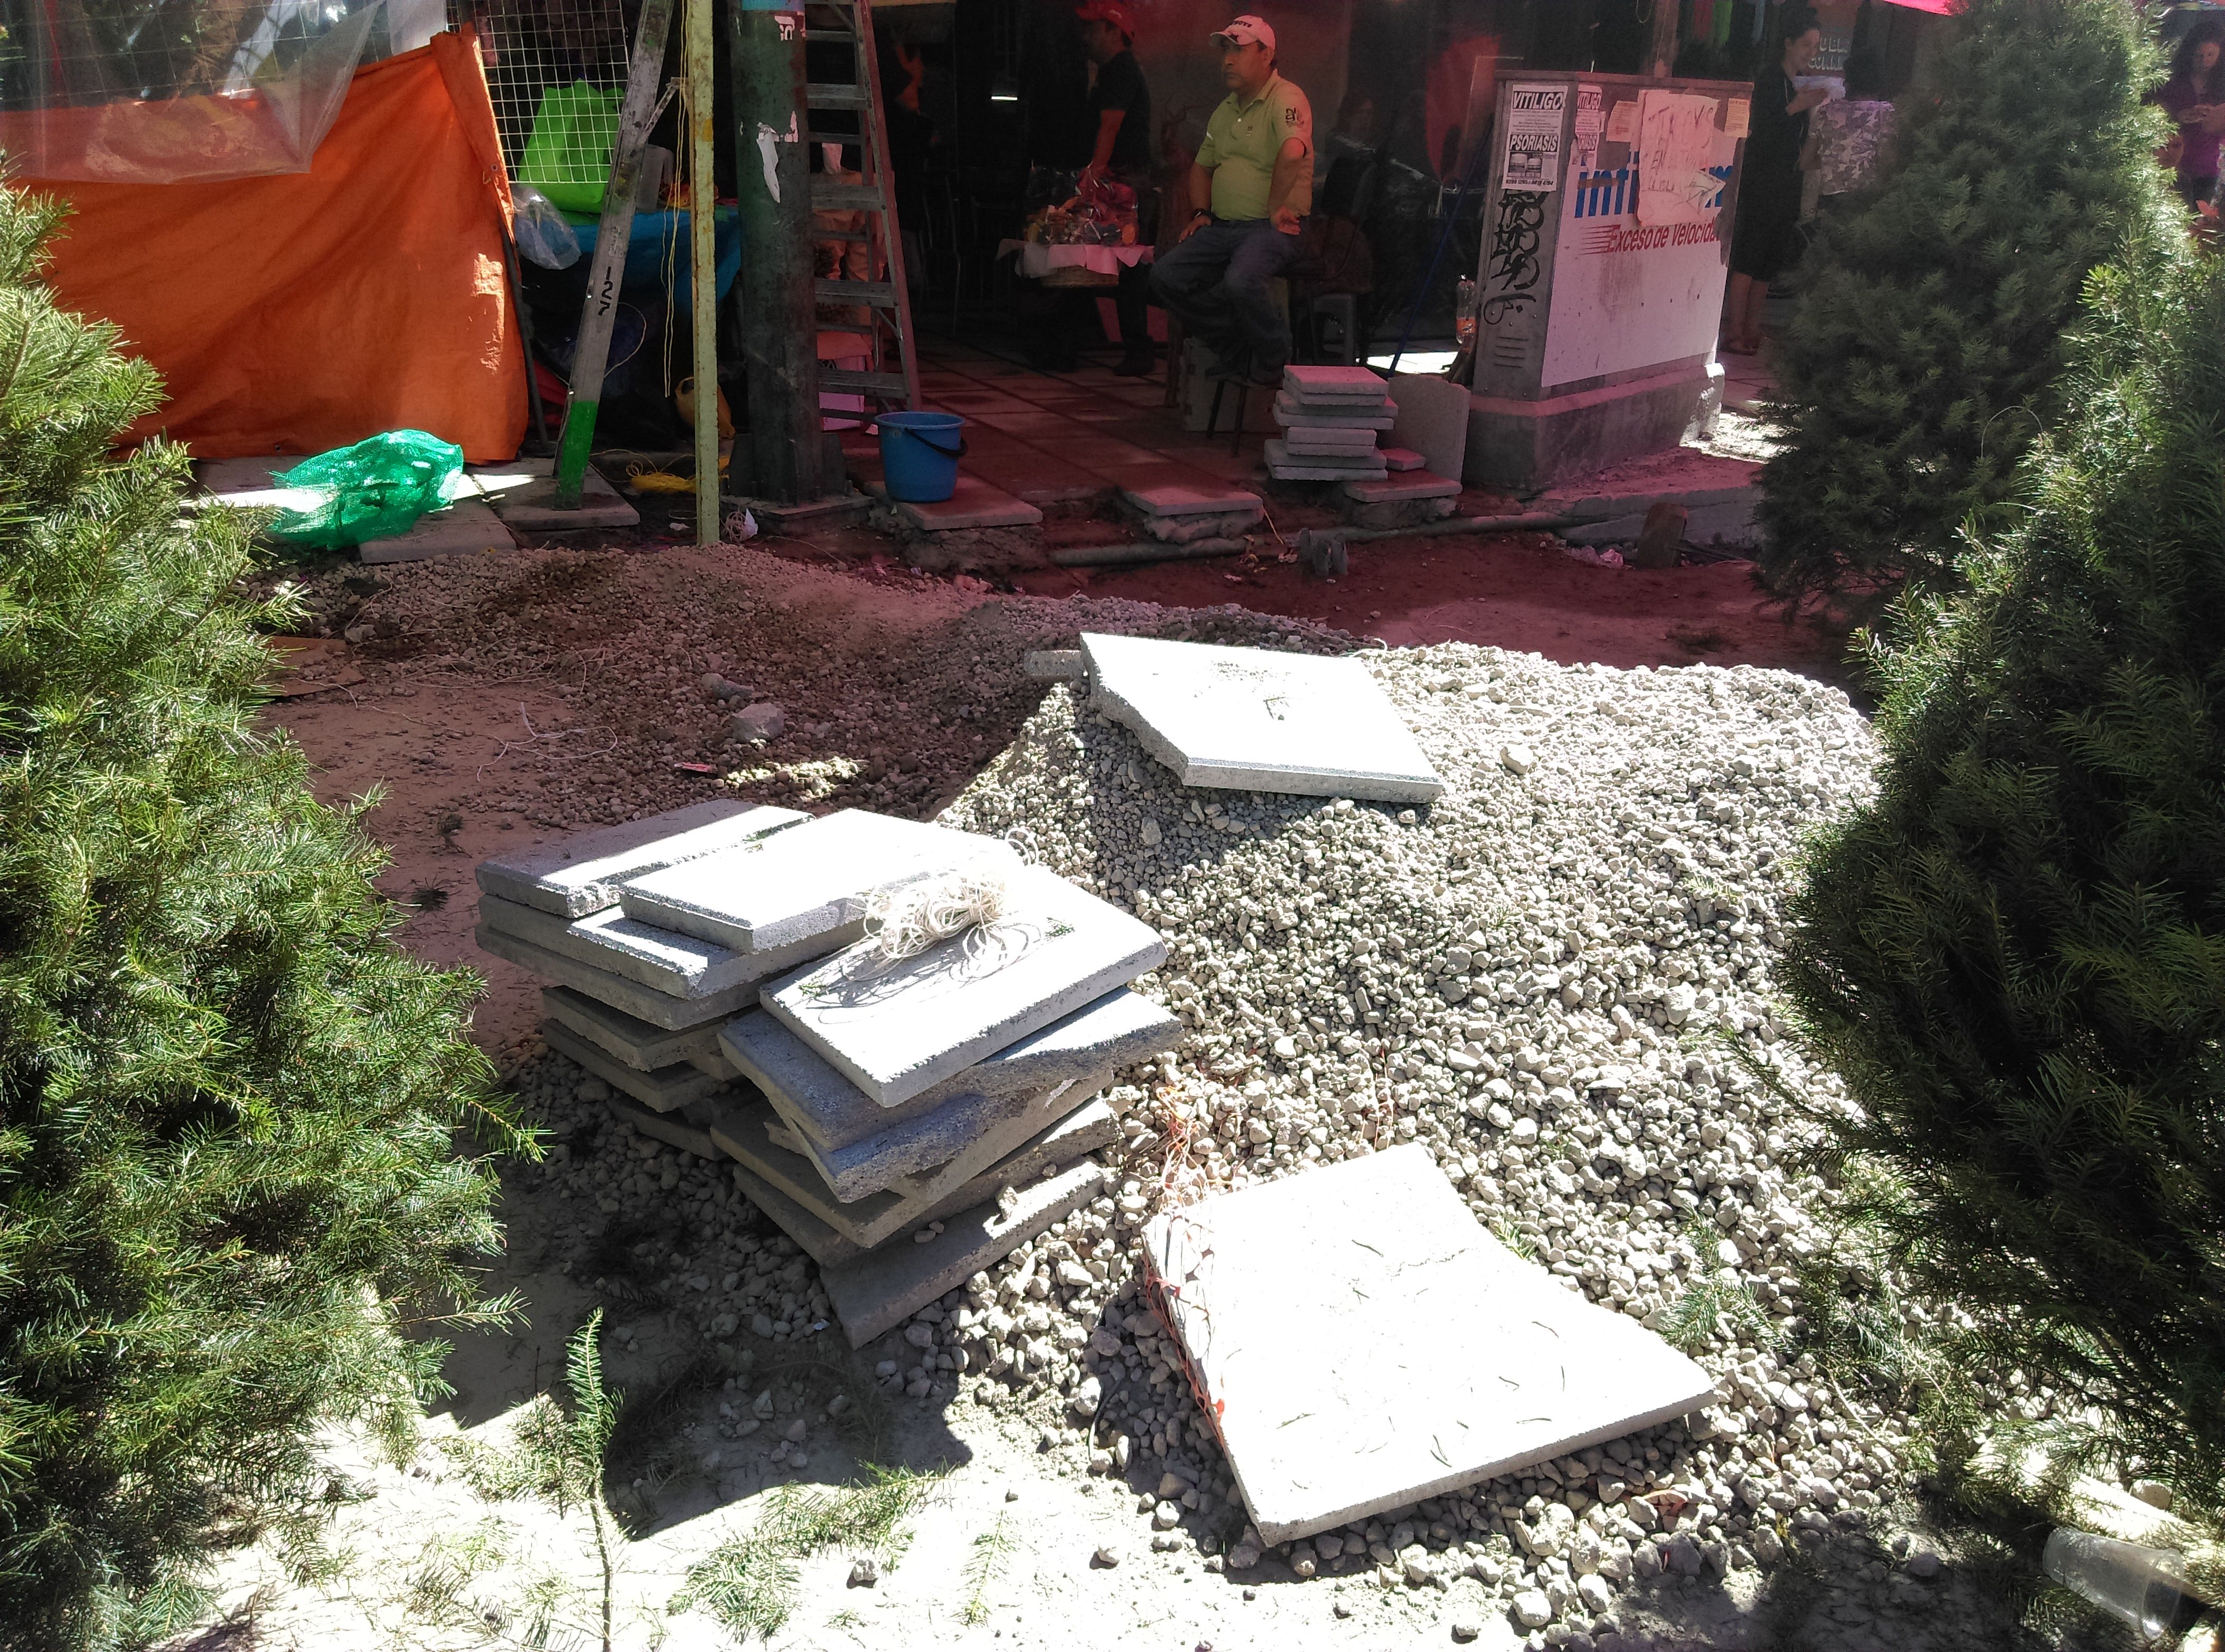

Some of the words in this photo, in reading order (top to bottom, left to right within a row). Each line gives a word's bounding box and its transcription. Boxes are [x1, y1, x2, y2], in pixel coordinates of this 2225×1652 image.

[1513, 92, 1563, 110] VITILIGO
[1510, 135, 1558, 152] PSORIASIS
[1607, 224, 1653, 253] Exceso
[1653, 227, 1669, 249] de
[1671, 217, 1720, 247] Velocida
